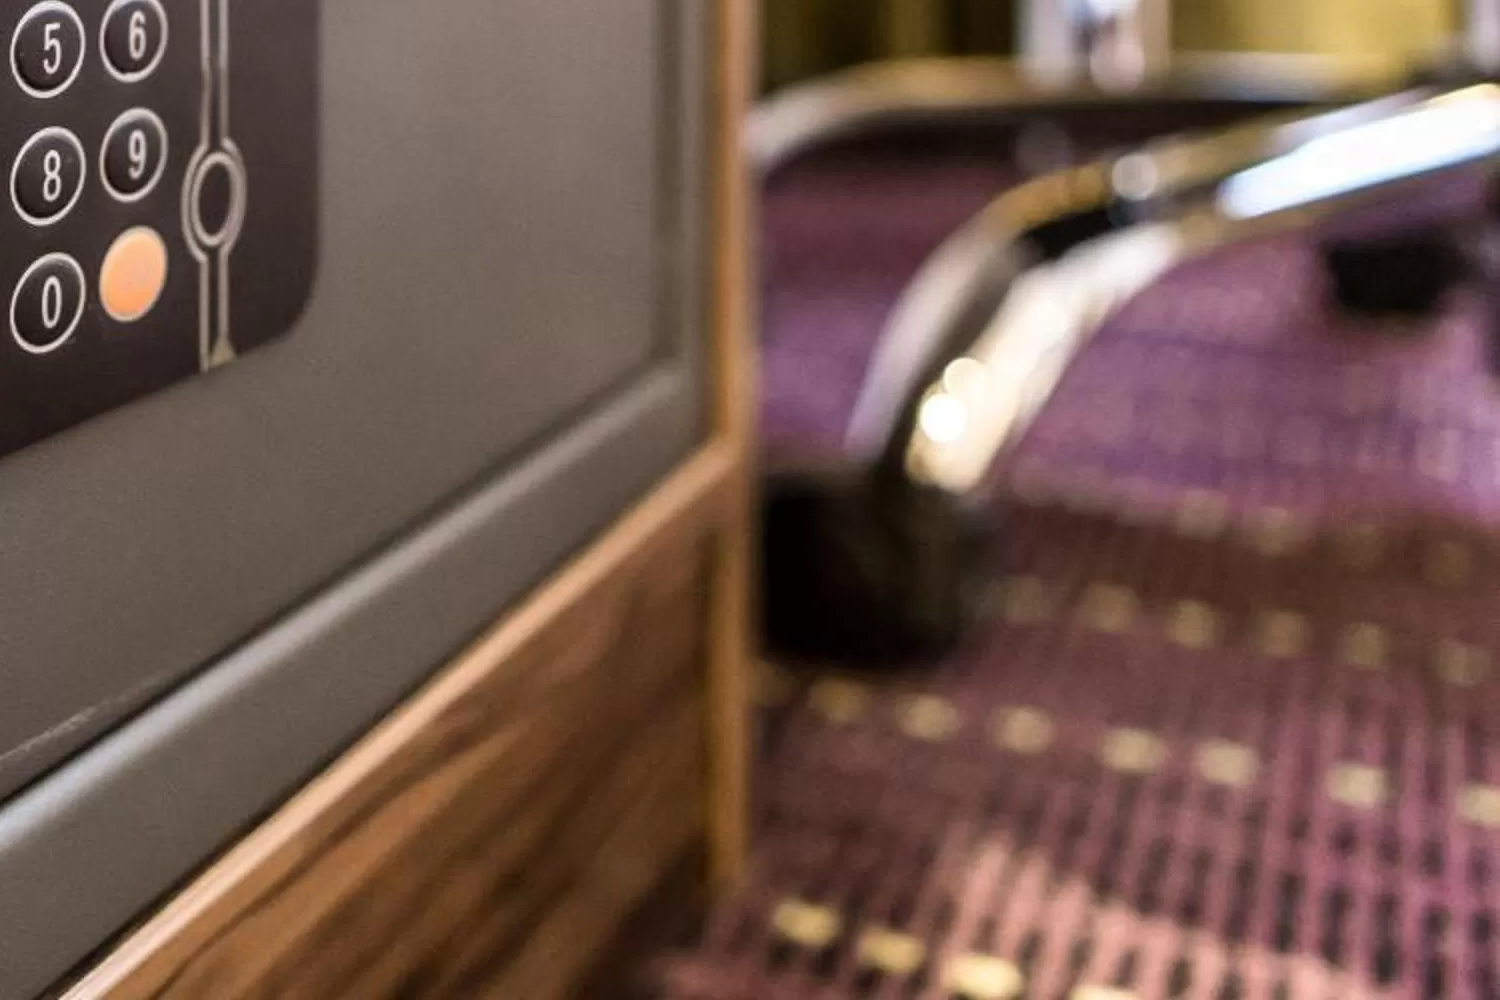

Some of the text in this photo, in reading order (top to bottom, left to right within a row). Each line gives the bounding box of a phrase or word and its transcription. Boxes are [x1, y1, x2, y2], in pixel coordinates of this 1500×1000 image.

[43, 22, 61, 75] 5
[129, 9, 146, 60] 6
[43, 149, 61, 202] 8
[129, 129, 146, 180] 9
[41, 275, 63, 329] 0
